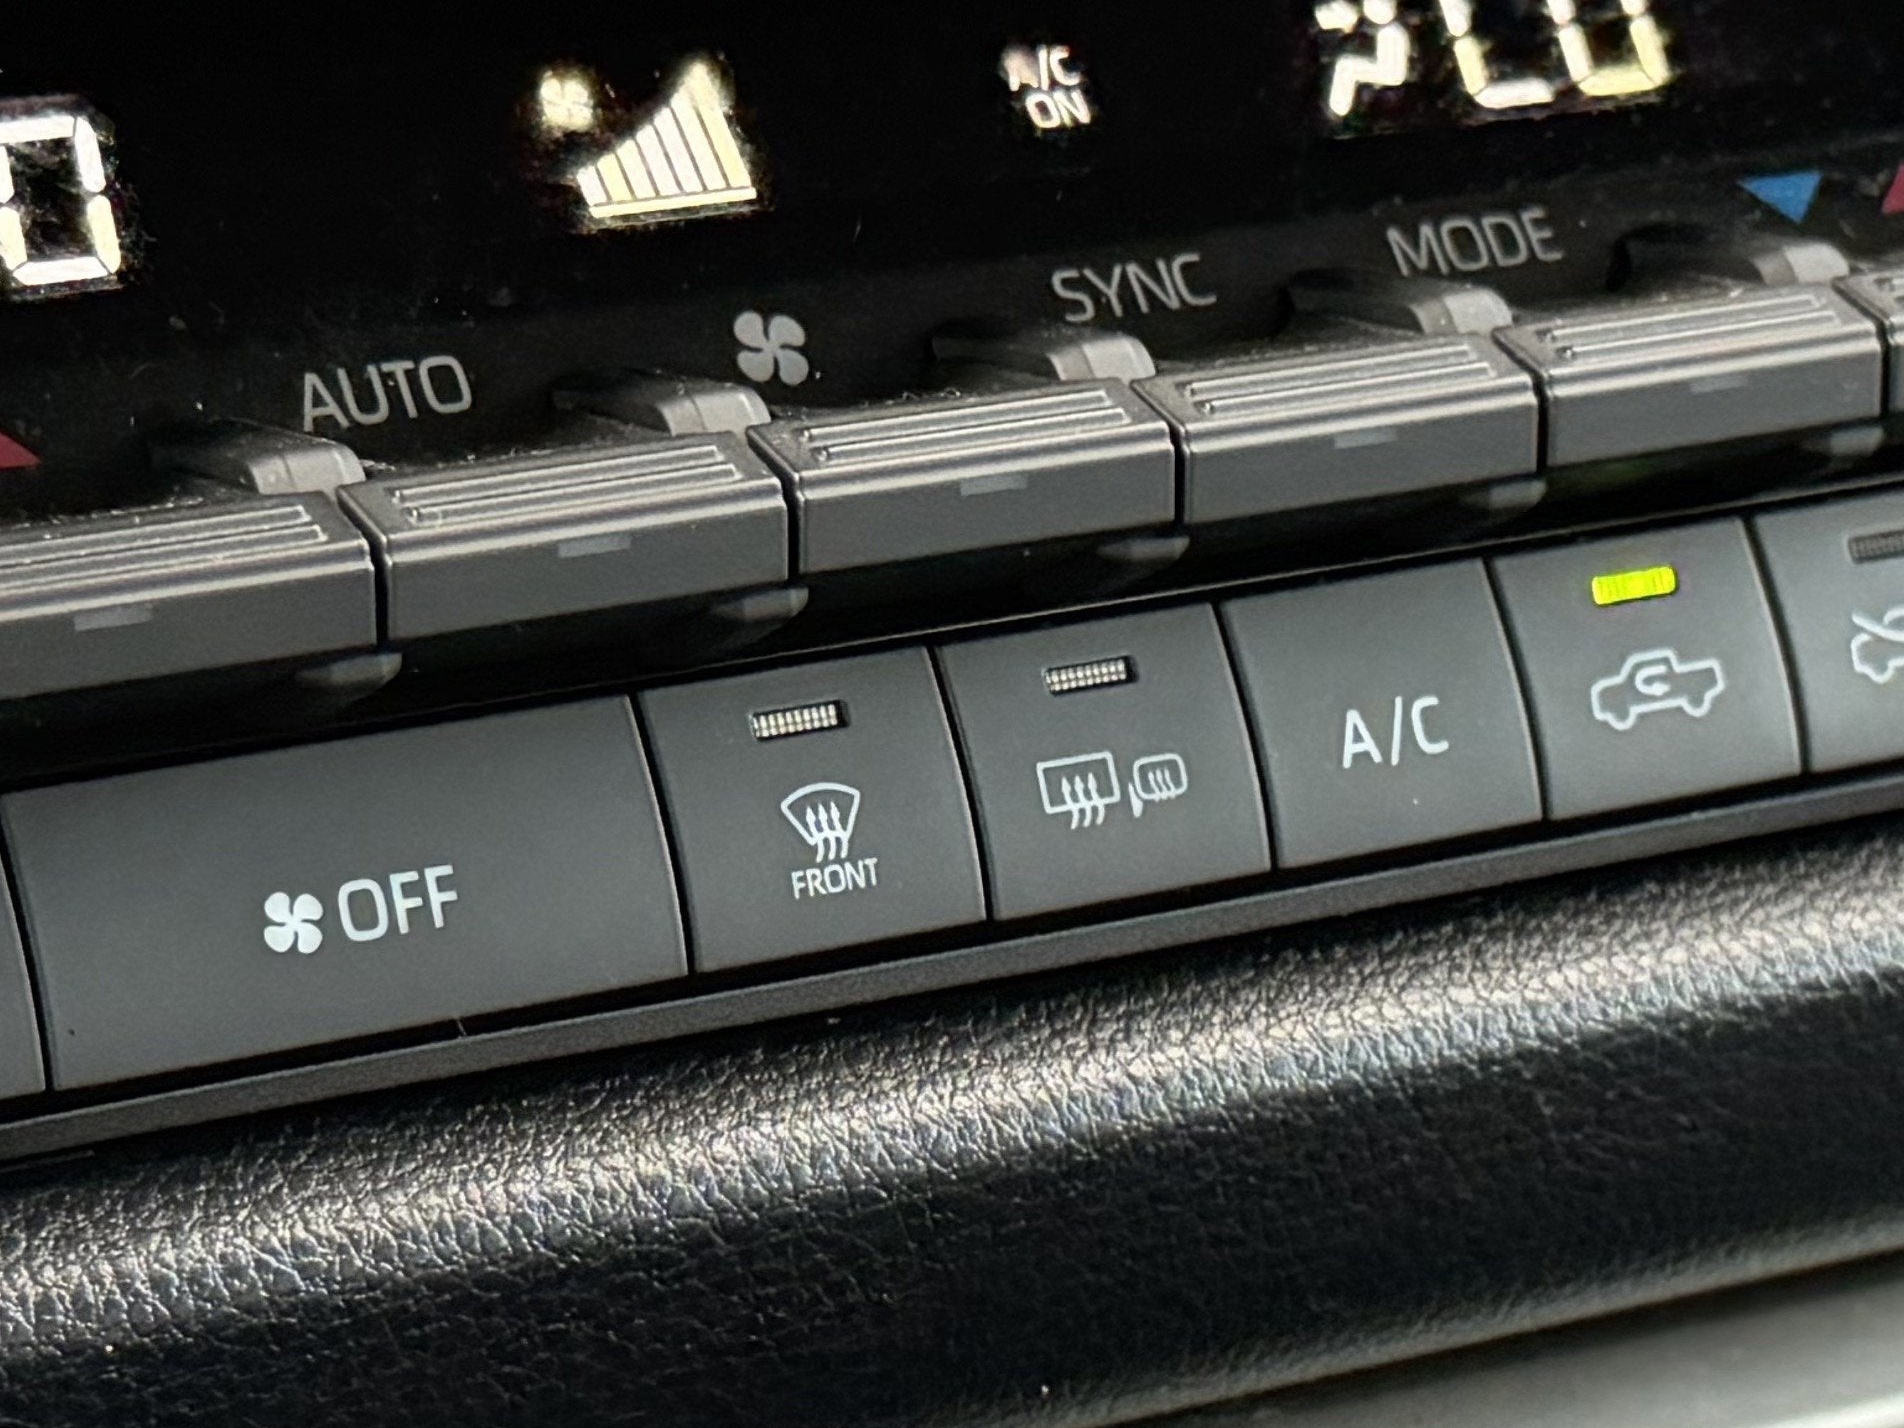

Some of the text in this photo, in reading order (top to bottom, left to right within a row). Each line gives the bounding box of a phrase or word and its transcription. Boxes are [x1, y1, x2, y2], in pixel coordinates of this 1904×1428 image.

[1025, 88, 1091, 128] ON
[1385, 206, 1564, 278] MODE
[1050, 252, 1218, 324] SYNC
[302, 354, 473, 433] AUTO
[1341, 694, 1451, 770] A/C
[336, 863, 459, 943] OFF
[790, 856, 879, 901] FRONT
